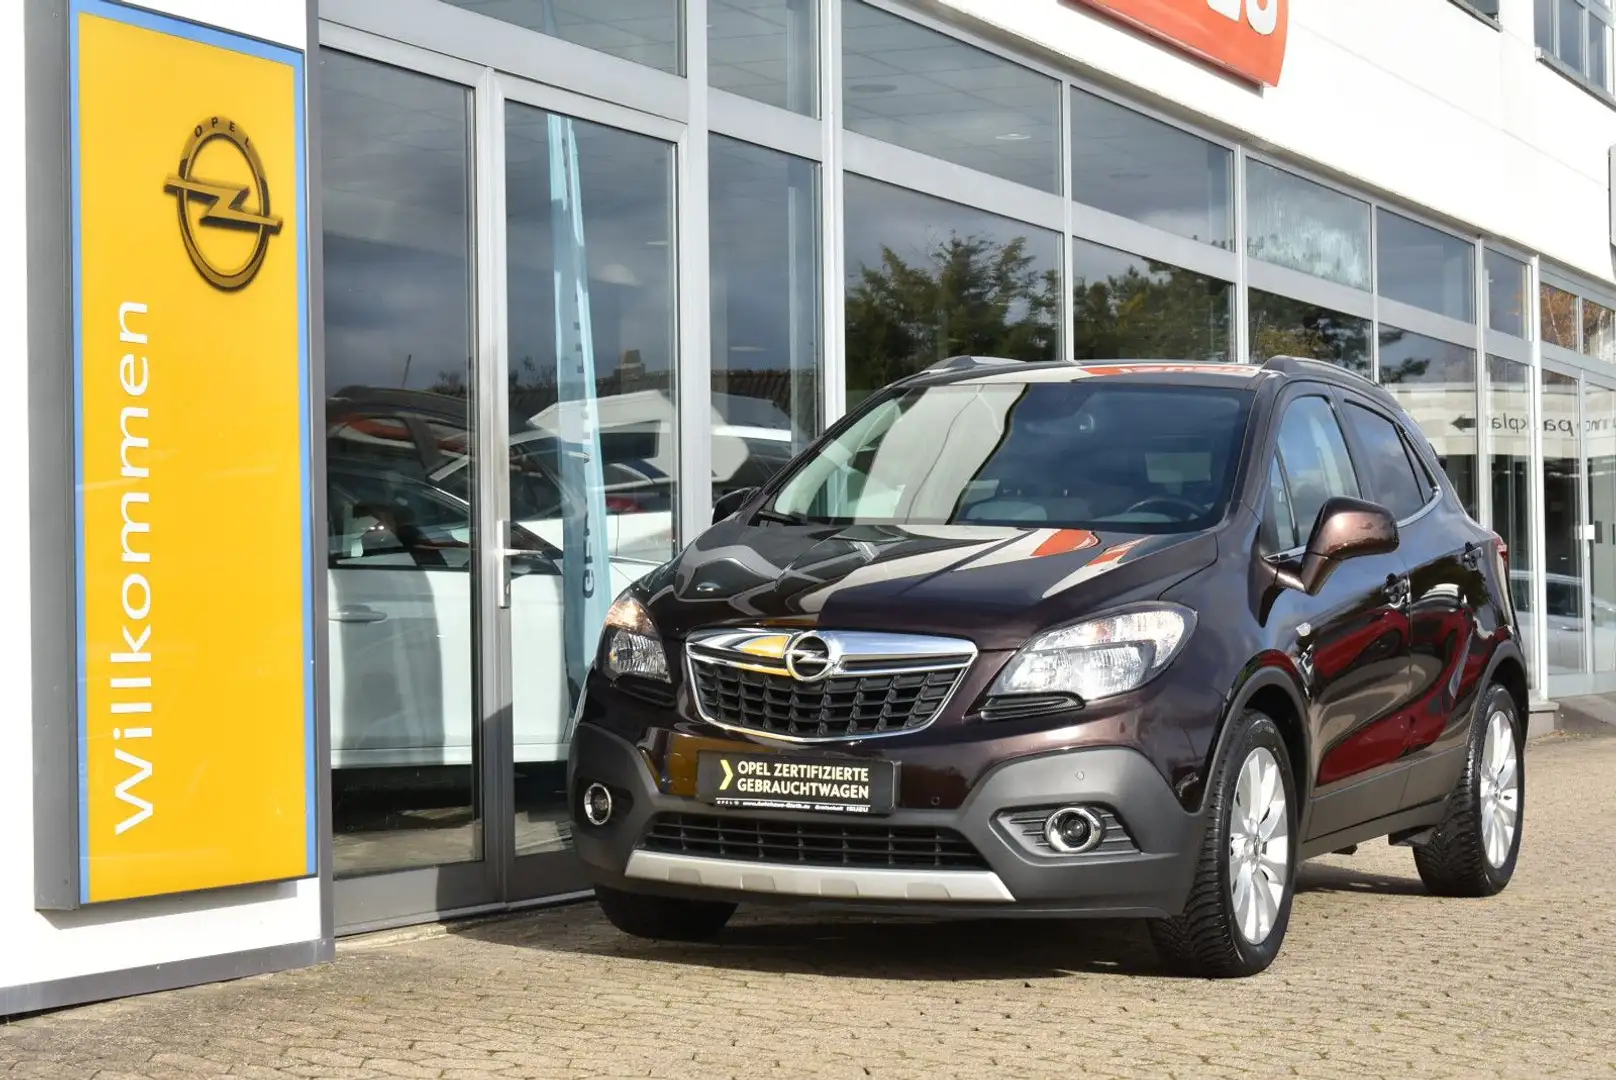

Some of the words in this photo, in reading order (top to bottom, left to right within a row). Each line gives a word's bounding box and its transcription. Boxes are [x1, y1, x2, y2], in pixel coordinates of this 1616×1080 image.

[194, 116, 250, 149] OPEL
[110, 300, 154, 836] Willkommen
[737, 760, 771, 776] OPEL
[773, 763, 869, 782] ZERTIFIZIERTE
[737, 778, 869, 799] GEBRAUCHTWAGEN
